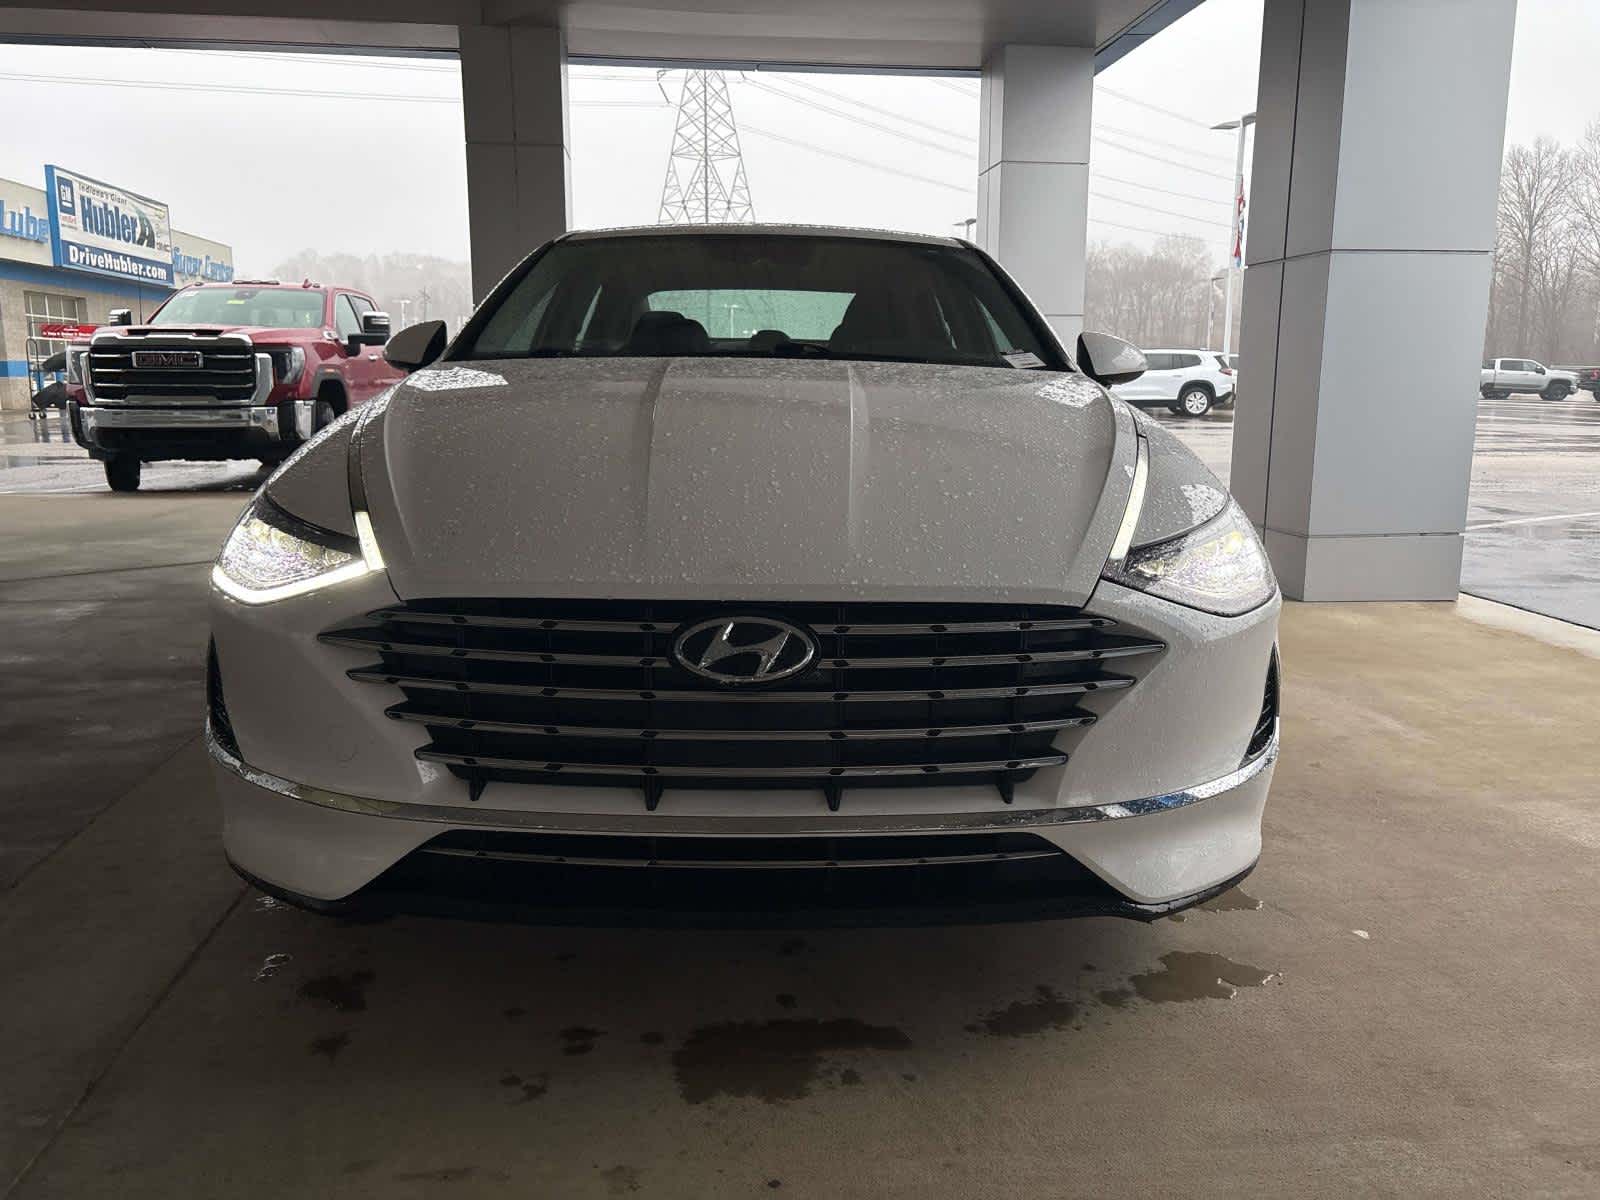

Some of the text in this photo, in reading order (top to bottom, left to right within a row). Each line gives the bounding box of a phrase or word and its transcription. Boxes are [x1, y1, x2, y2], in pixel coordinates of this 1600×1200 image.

[60, 185, 72, 202] GM
[80, 195, 138, 244] Hubler
[69, 245, 167, 280] DriveHubler.com
[136, 353, 199, 368] GMC
